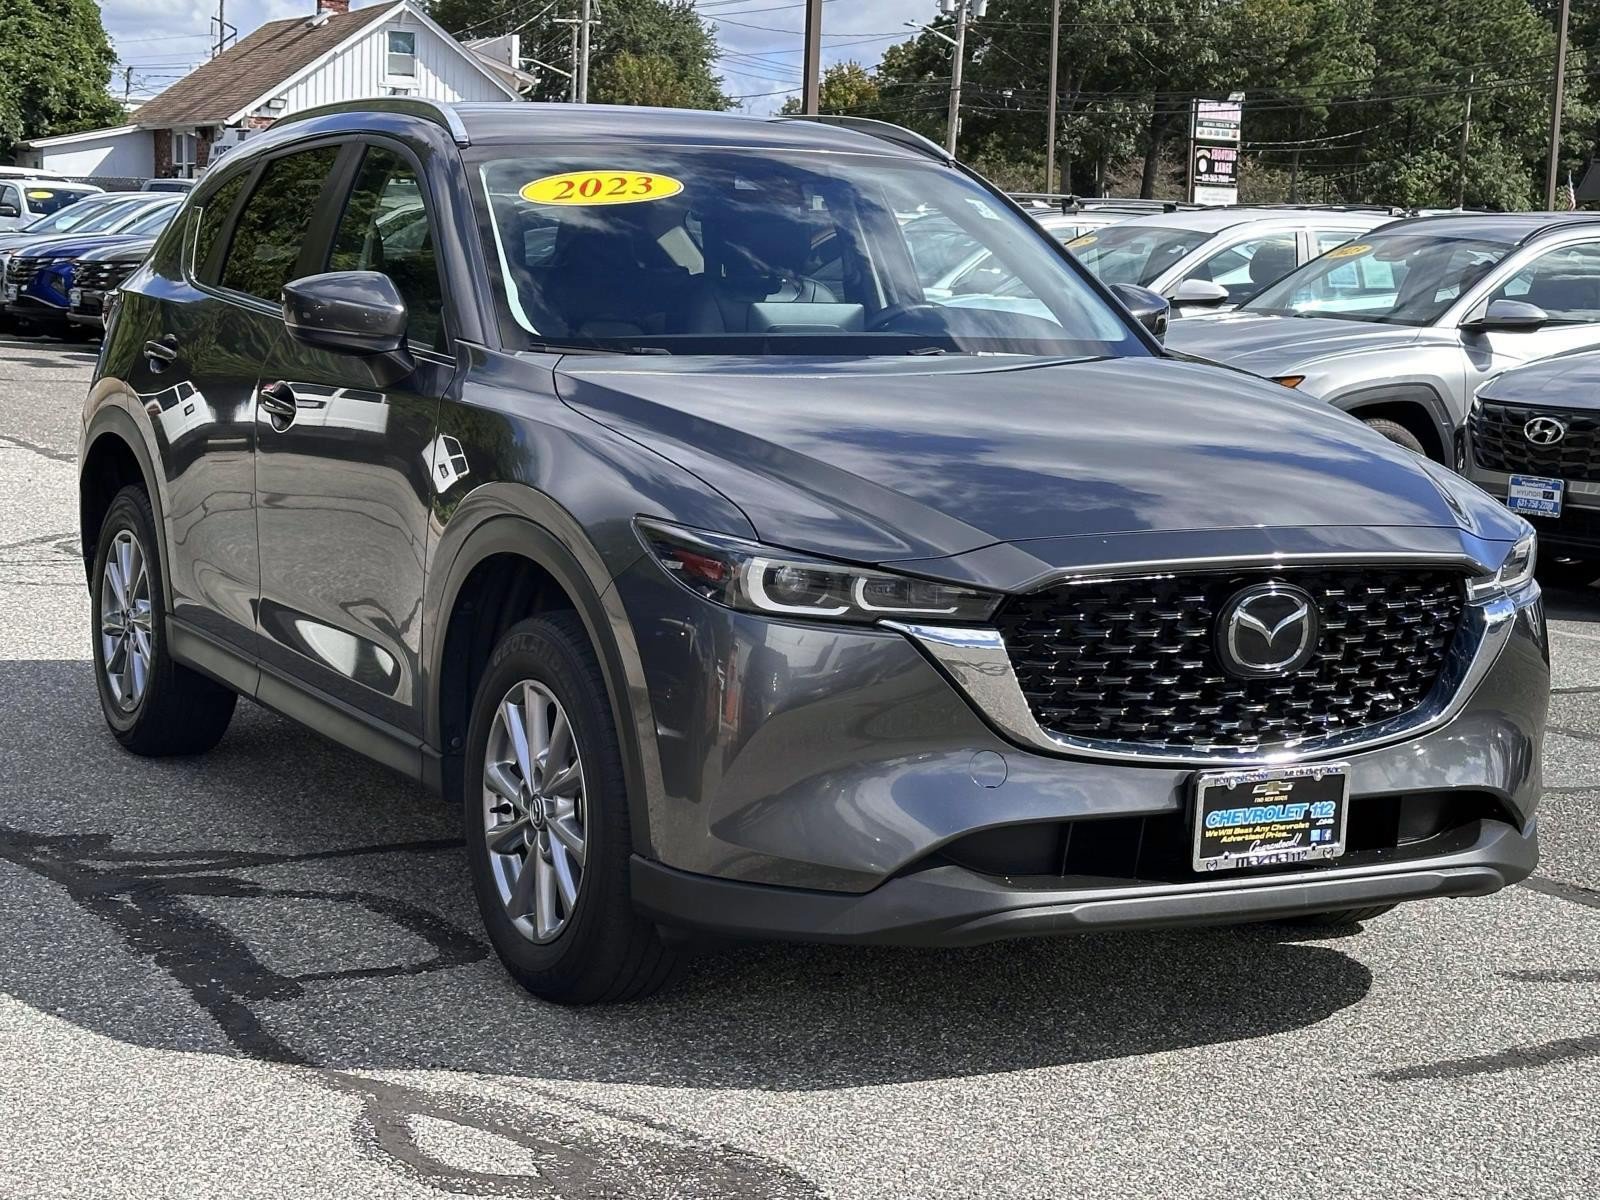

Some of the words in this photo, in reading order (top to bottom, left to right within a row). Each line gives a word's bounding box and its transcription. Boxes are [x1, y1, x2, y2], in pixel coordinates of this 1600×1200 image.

[552, 176, 653, 200] 2023
[1206, 803, 1310, 829] CHEVROLET
[1309, 800, 1336, 819] 112
[1256, 825, 1271, 834] Any
[1271, 822, 1310, 831] Chevrolet
[1291, 850, 1308, 862] 112
